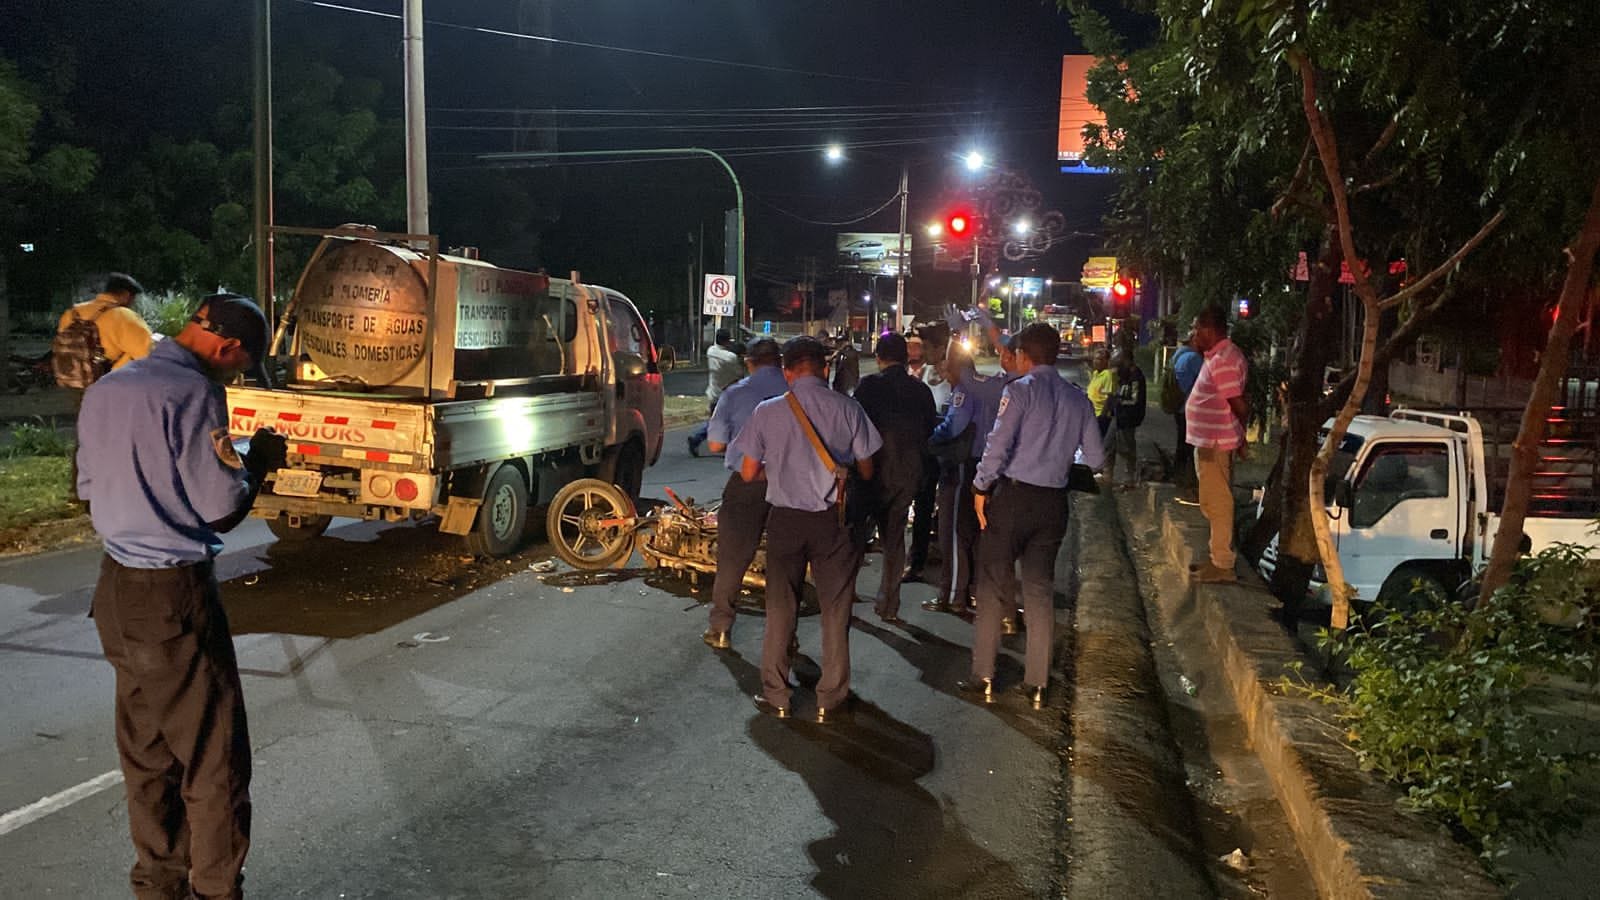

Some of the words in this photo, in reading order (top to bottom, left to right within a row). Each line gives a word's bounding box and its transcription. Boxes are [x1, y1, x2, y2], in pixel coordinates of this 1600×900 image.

[303, 308, 354, 330] TRANSPORTE
[363, 316, 376, 333] DE
[385, 317, 424, 335] AGUAS
[460, 305, 507, 320] TRANSPORTE
[458, 331, 502, 346] RESIDUALES
[231, 415, 265, 433] KIA
[275, 421, 366, 443] MOTORS
